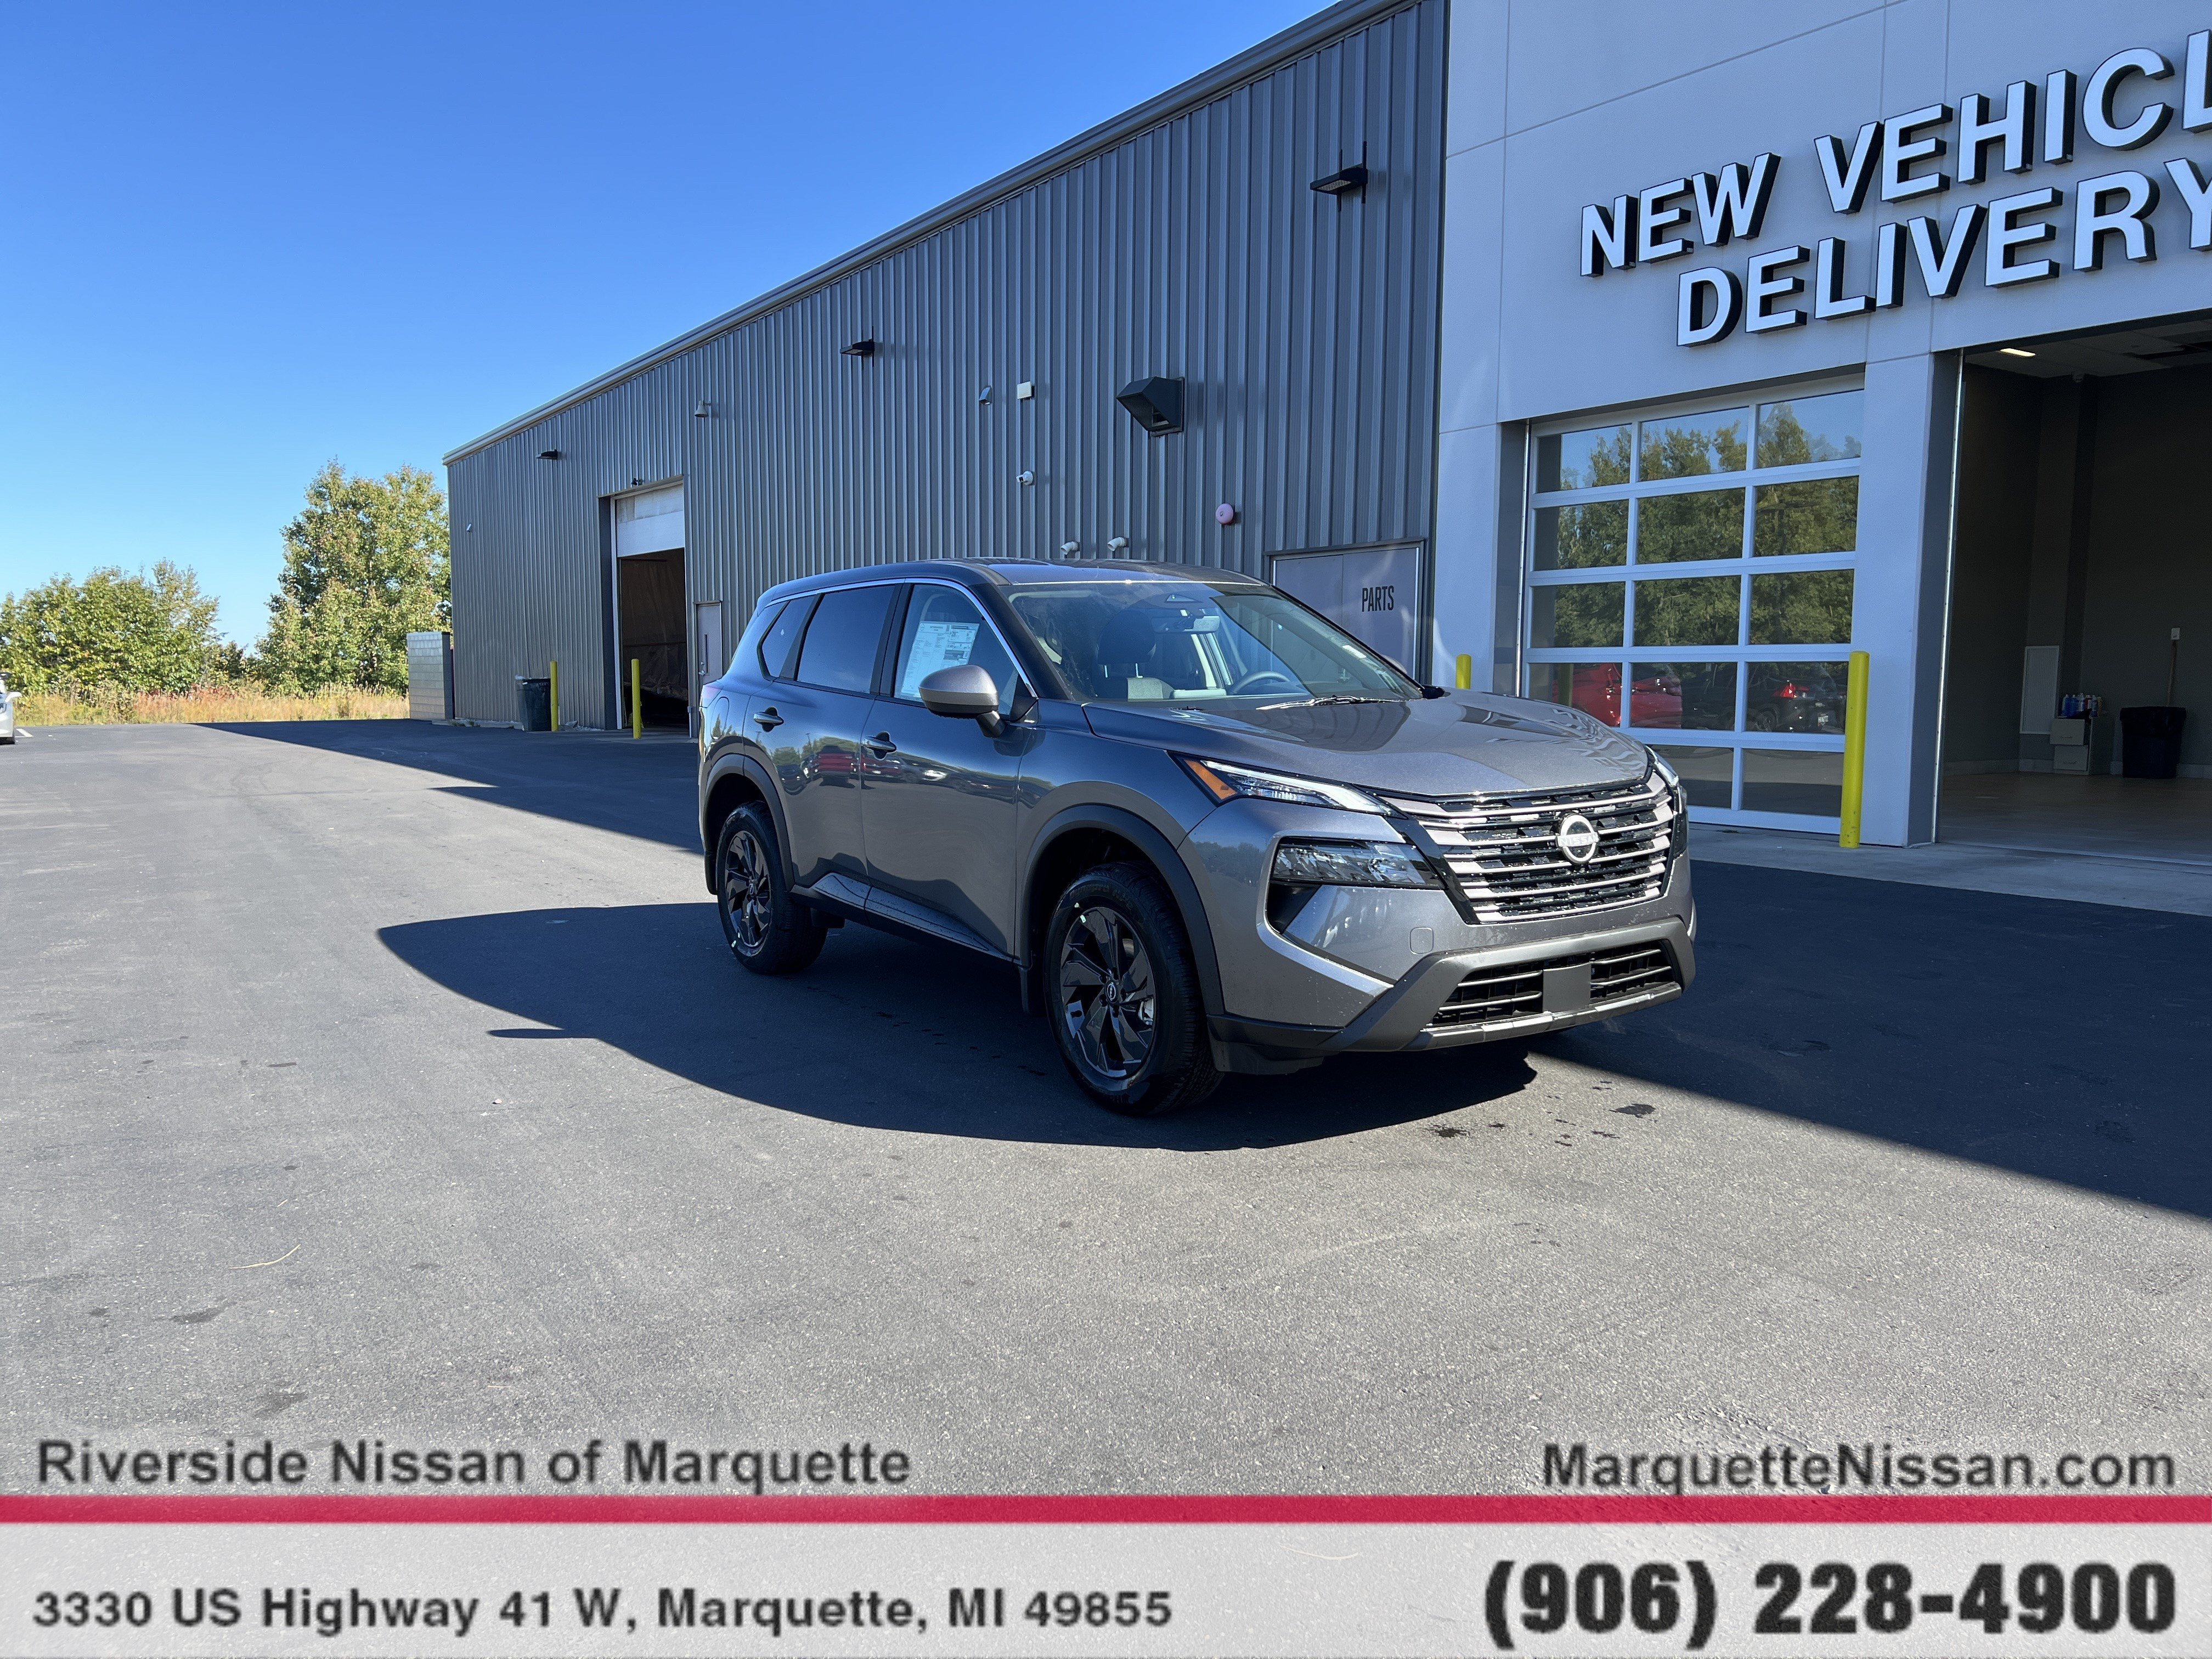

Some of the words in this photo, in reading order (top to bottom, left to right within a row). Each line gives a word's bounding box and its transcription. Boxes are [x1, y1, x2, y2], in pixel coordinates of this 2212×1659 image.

[1581, 153, 1781, 276] NEW
[1677, 157, 2212, 347] DELIVERY
[1362, 585, 1394, 612] PARTS
[1558, 832, 1599, 846] NISSAN
